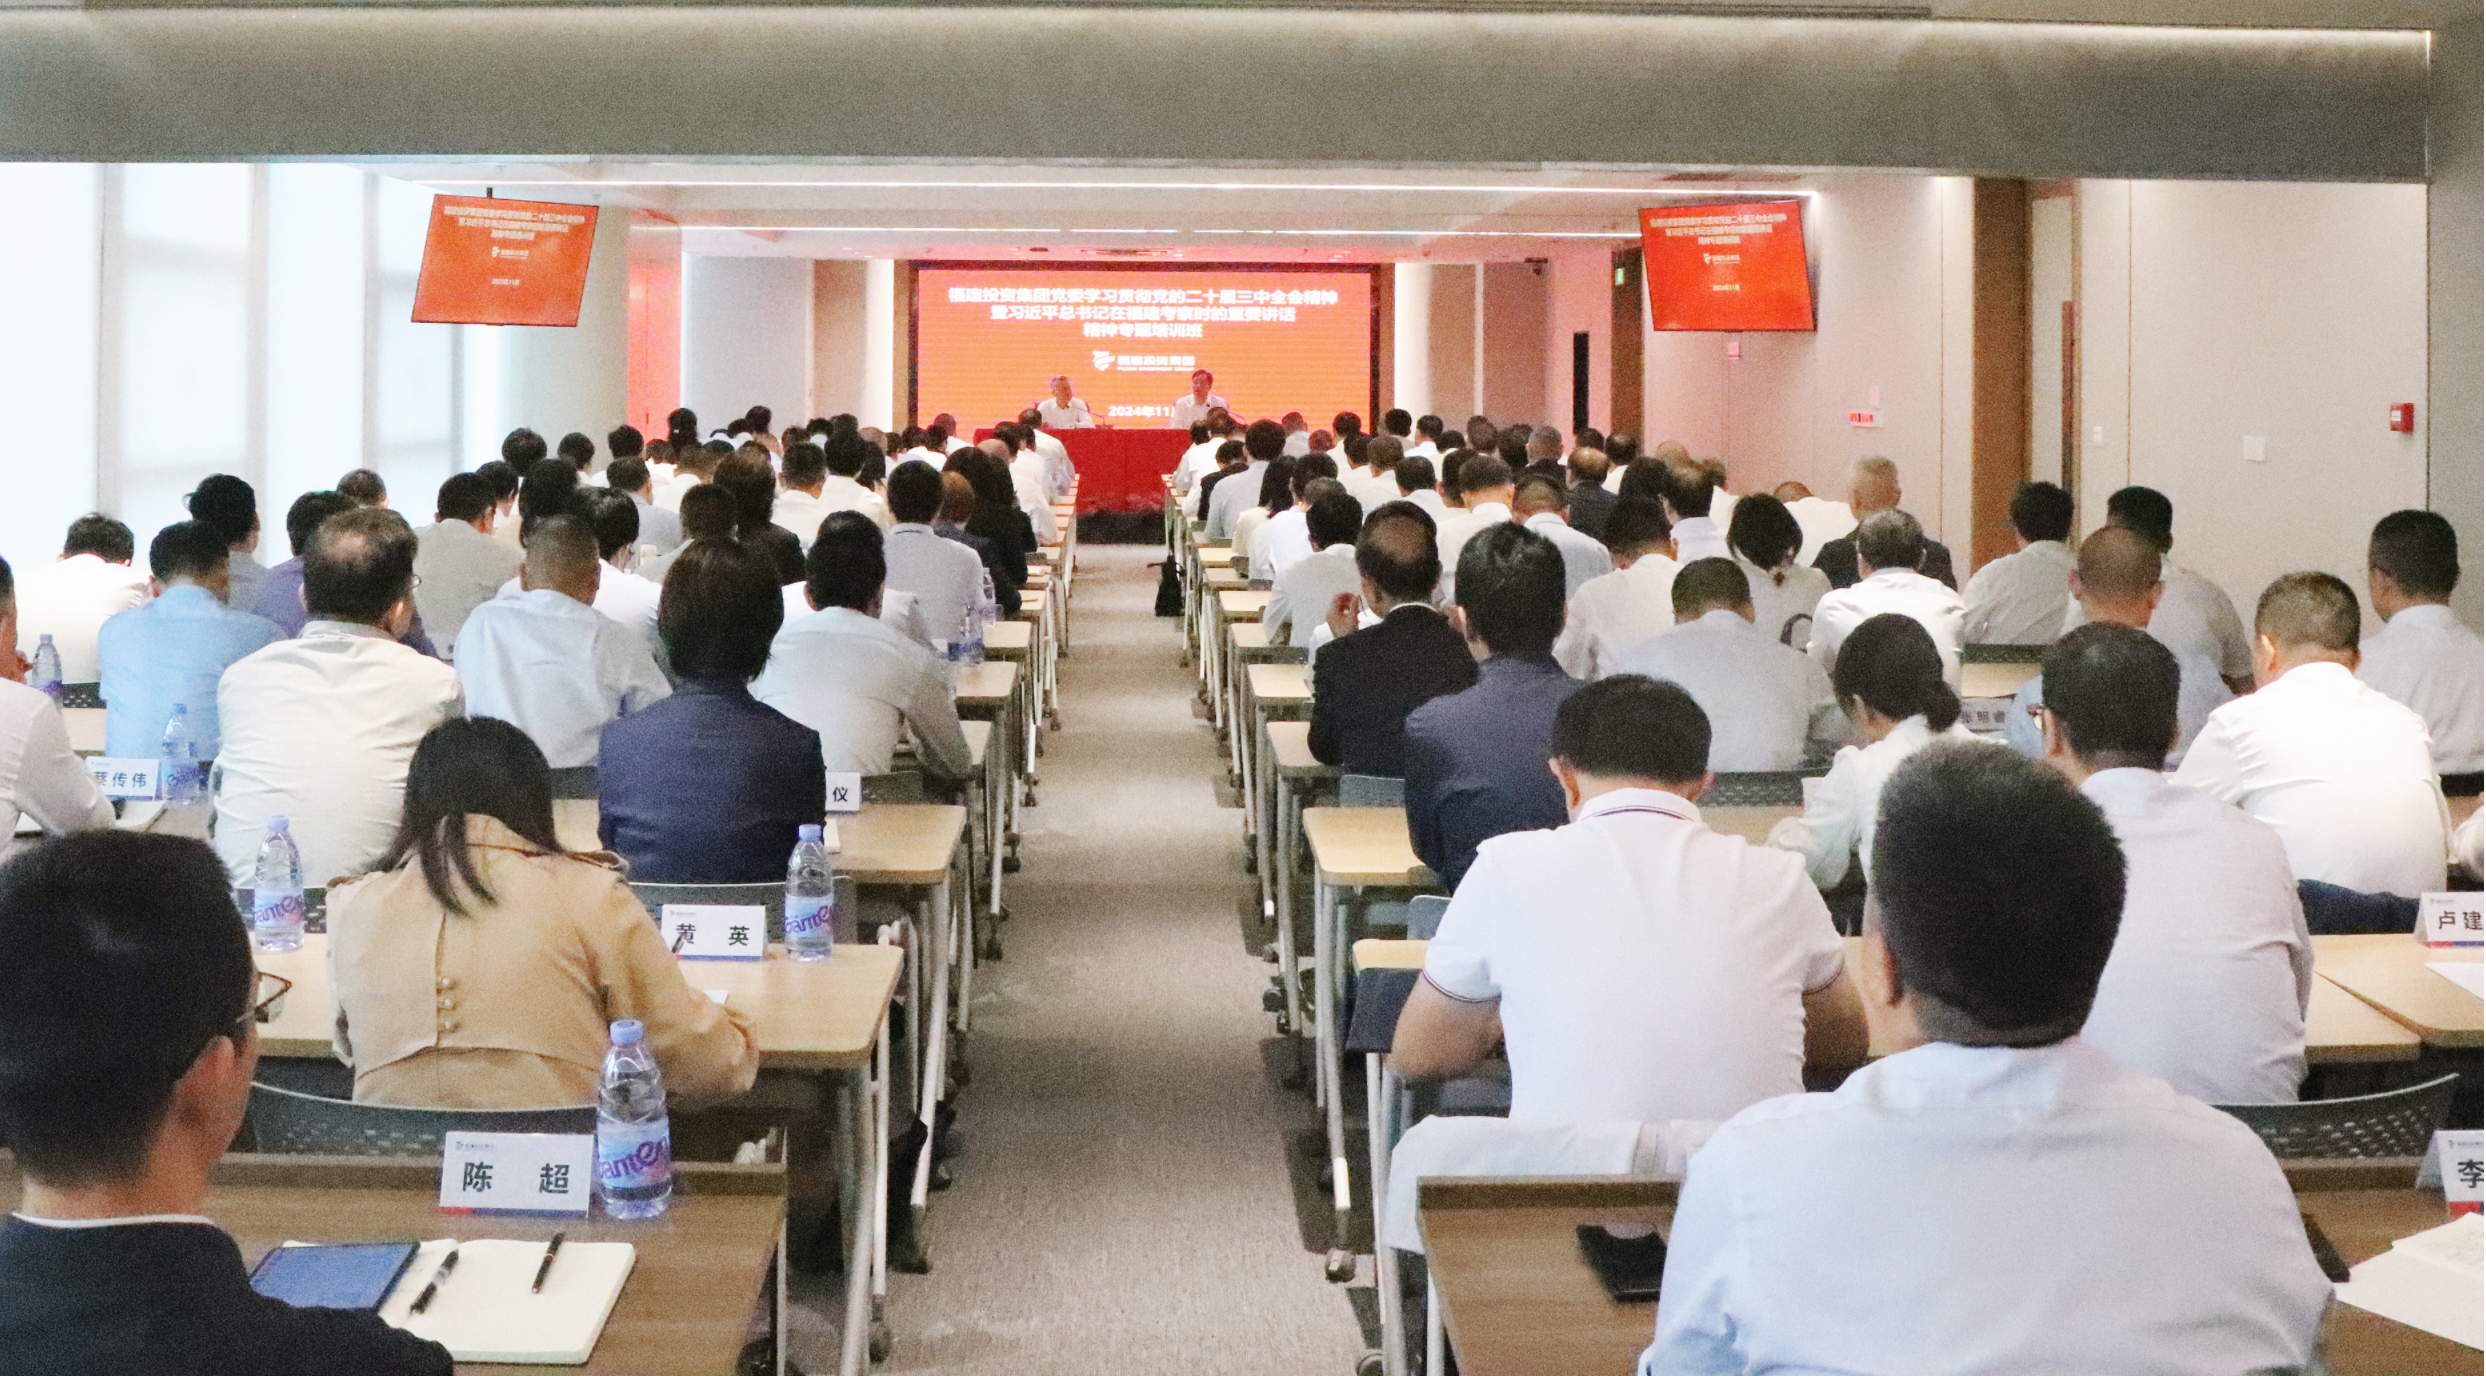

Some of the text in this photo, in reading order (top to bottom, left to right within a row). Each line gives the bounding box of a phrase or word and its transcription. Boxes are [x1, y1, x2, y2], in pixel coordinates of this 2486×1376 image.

[1083, 322, 1203, 338] 精神专题培训班
[833, 786, 848, 802] 仪
[2439, 911, 2483, 930] 卢建
[463, 1161, 570, 1194] 陈超
[2458, 1159, 2484, 1188] 李
